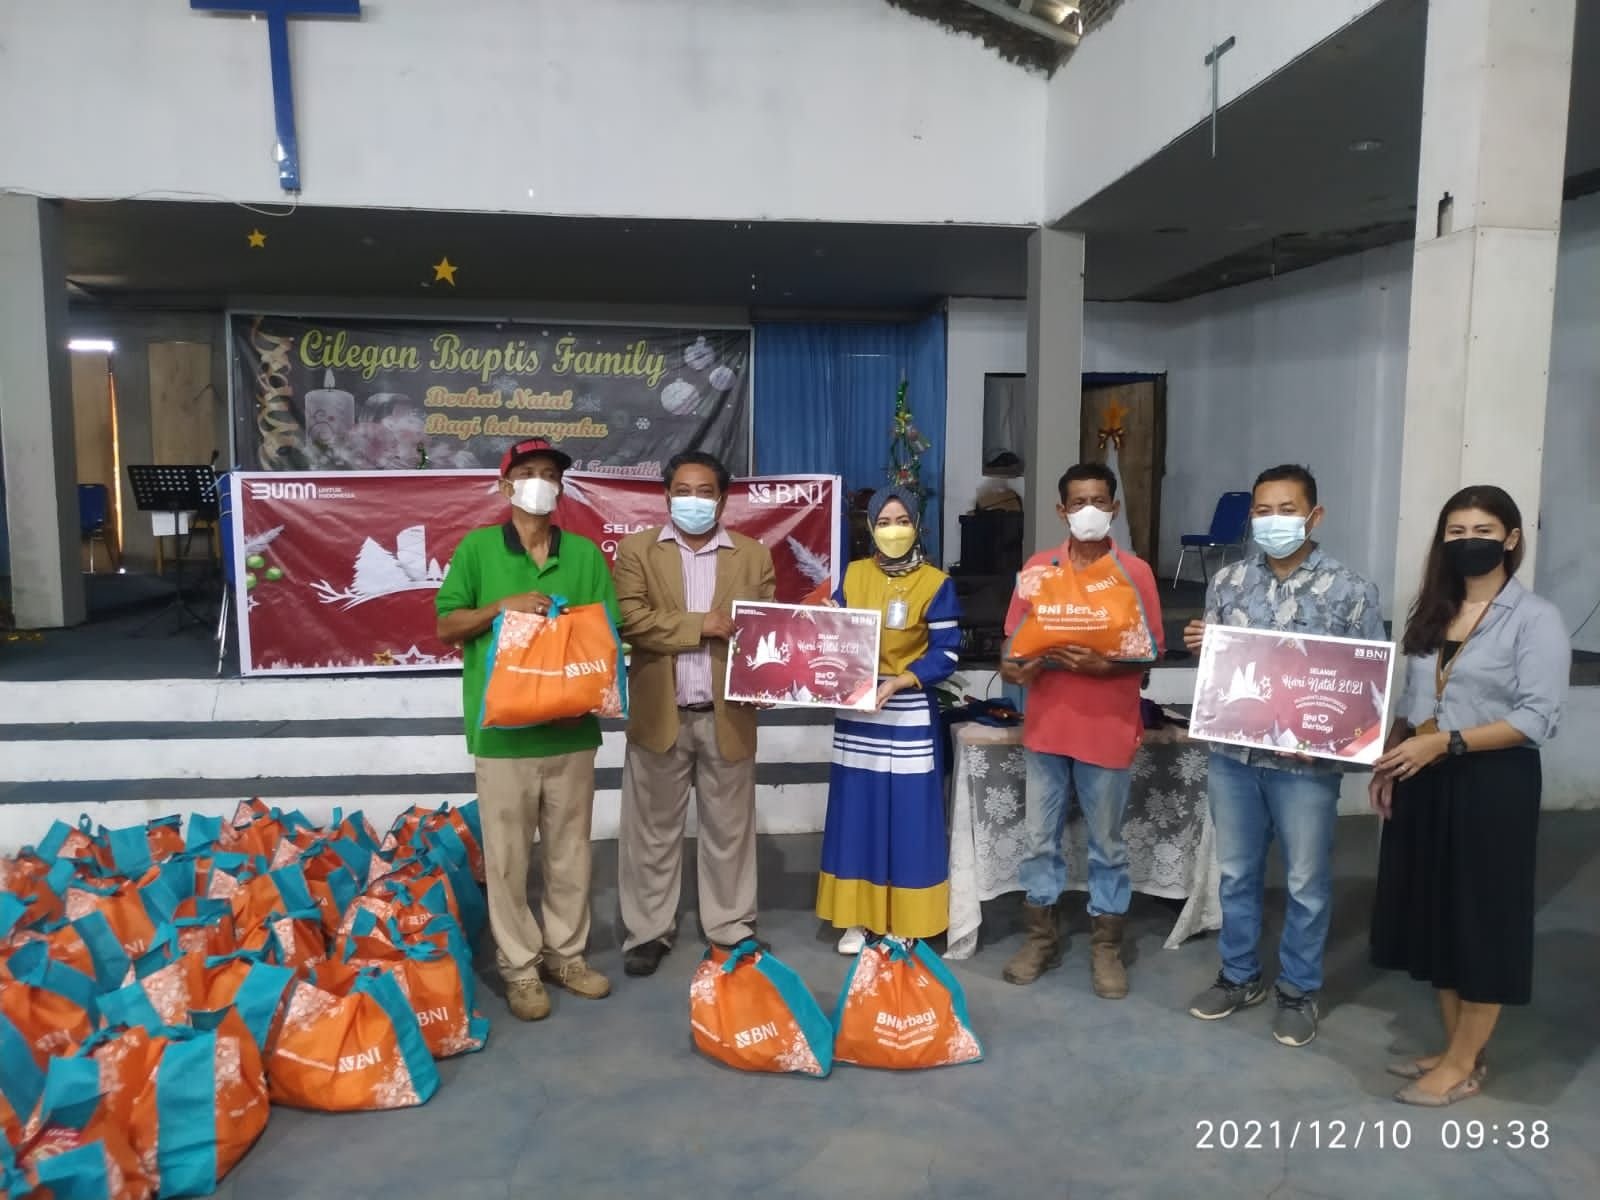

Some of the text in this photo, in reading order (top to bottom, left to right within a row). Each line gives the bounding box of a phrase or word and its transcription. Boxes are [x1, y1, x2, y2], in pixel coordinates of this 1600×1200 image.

[300, 330, 668, 389] Cilegon Baptis Family
[425, 386, 573, 410] Berkat Natal
[425, 414, 482, 440] Bagi
[775, 483, 824, 504] BNI
[1038, 604, 1061, 615] BNI
[1366, 649, 1387, 660] BNI
[579, 659, 608, 676] BNI
[1307, 677, 1337, 693] Natal
[1337, 680, 1363, 695] 2021
[415, 1006, 449, 1027] BNI
[751, 1020, 779, 1045] BNI
[356, 1046, 382, 1071] BNI
